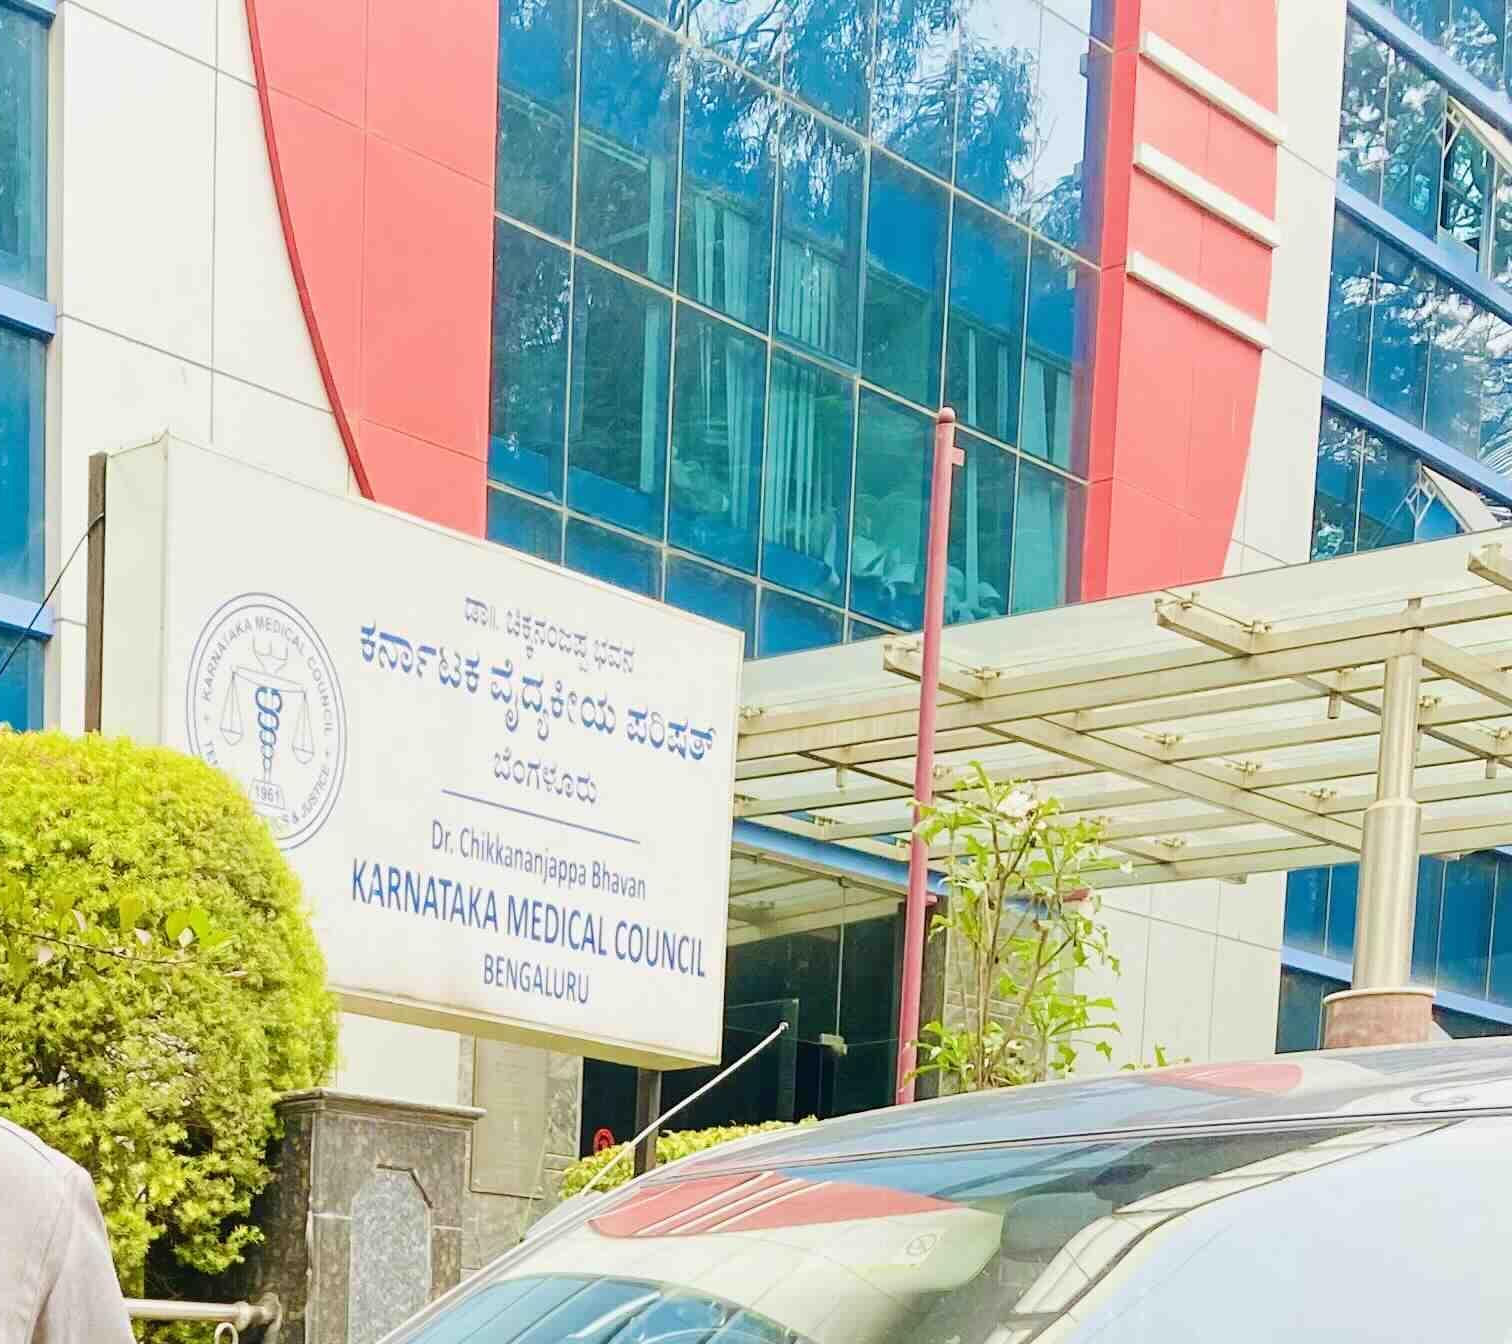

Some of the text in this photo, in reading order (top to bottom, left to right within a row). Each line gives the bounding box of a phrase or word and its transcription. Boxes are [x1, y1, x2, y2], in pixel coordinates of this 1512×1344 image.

[255, 616, 306, 657] MEDICAL
[307, 656, 334, 734] COUNCIL
[359, 619, 718, 761] ಕರ್ನಾಟಕ ವೈದ್ಯಕೀಯ ಪರಿಷತ್
[255, 785, 281, 803] 1961
[431, 820, 647, 901] Dr. Chikkananjappa Bhavan
[351, 857, 706, 978] KARNATAKA MEDICAL COUNCIL
[483, 953, 590, 1005] BENGALURU
